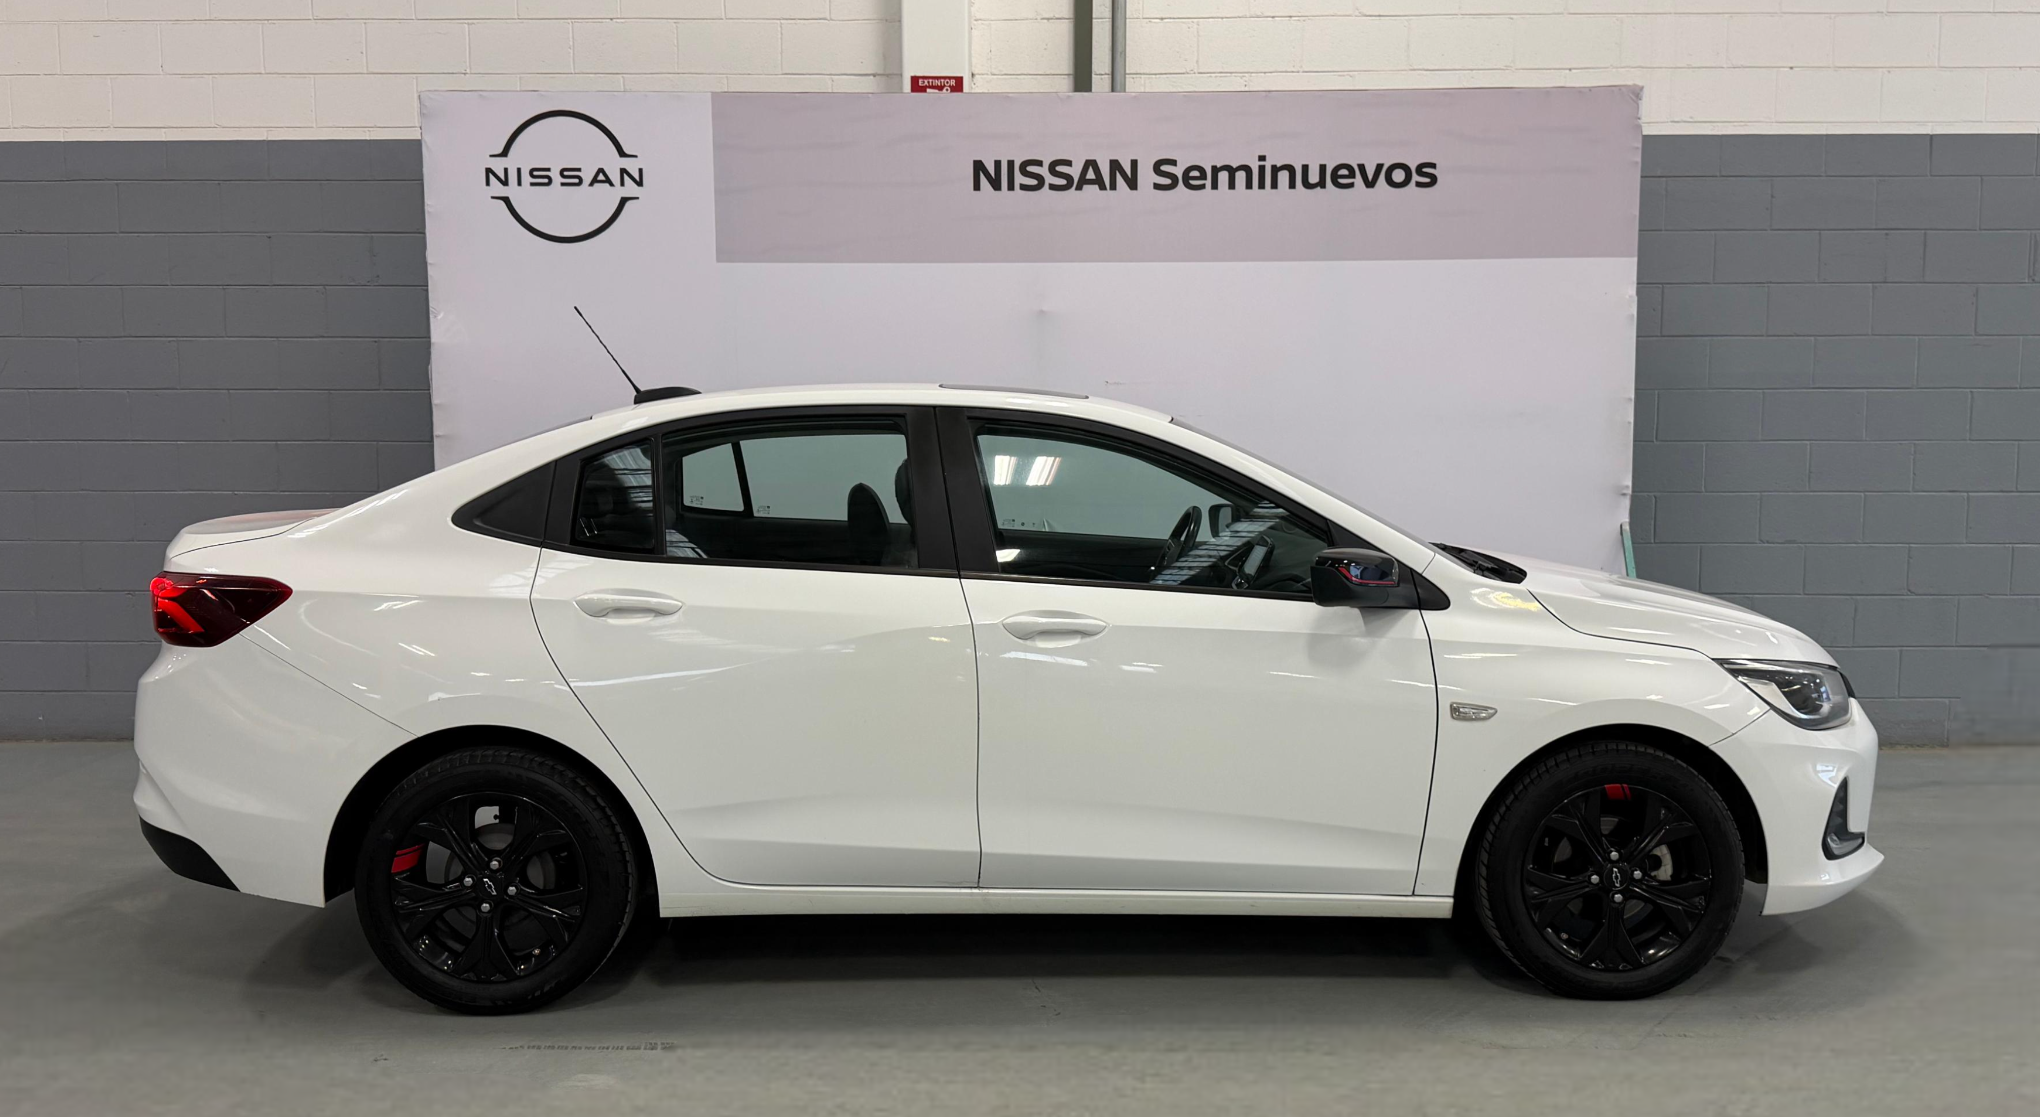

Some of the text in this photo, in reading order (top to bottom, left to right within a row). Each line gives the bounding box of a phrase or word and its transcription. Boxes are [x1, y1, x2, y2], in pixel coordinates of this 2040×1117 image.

[918, 78, 956, 87] EXTINTOR
[485, 166, 644, 188] NISSAN
[972, 154, 1438, 192] NISSAN Seminuevos
